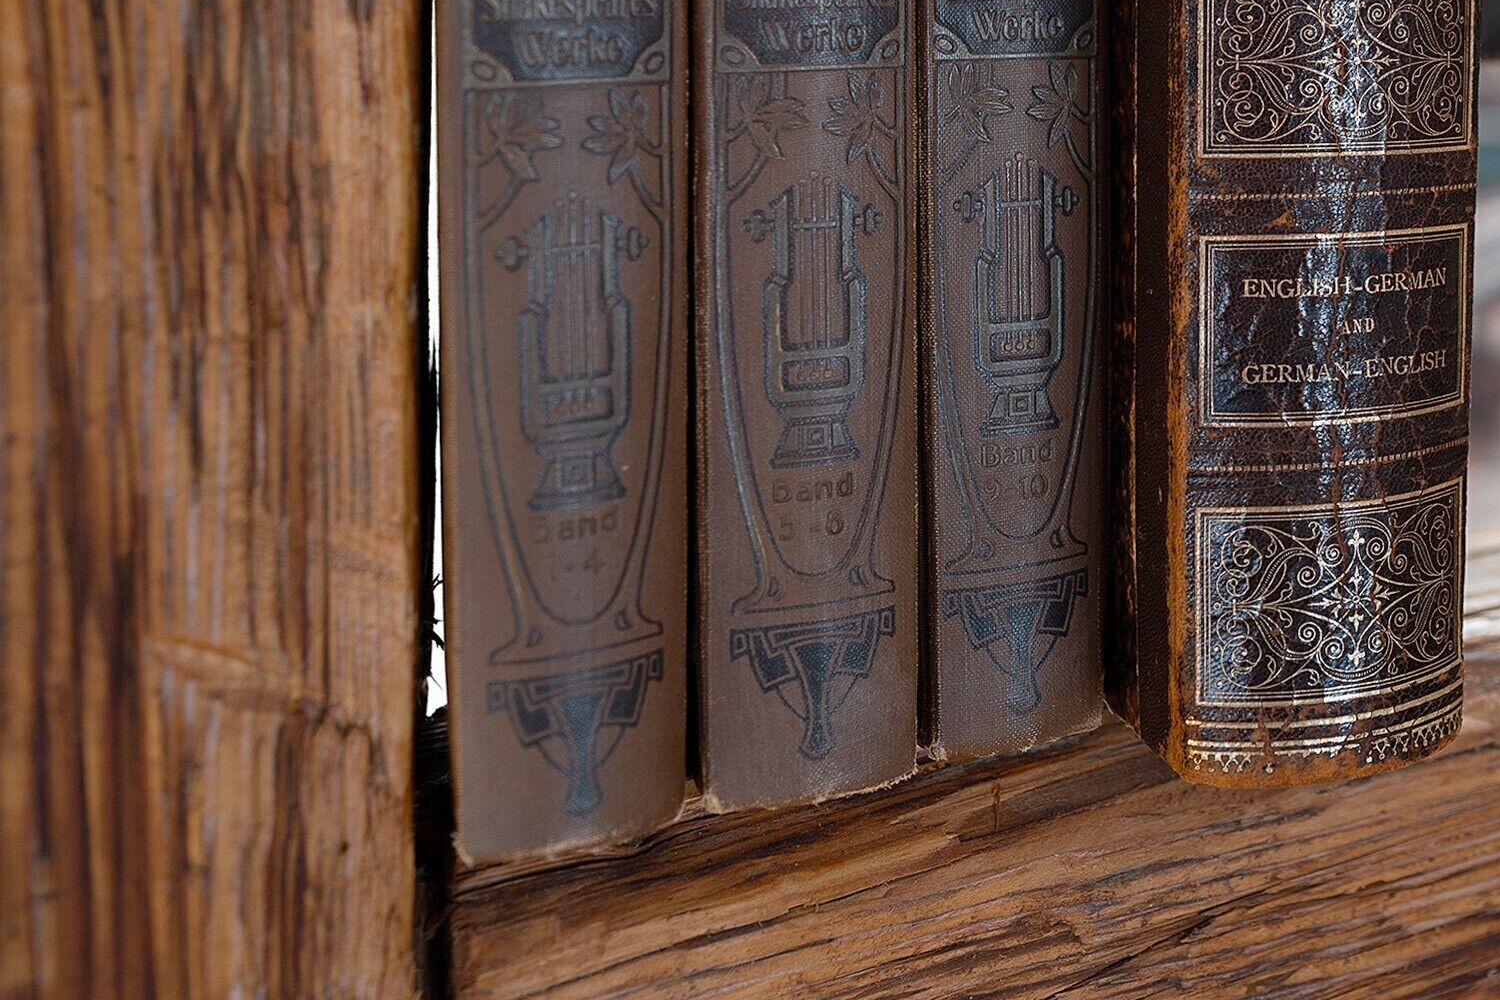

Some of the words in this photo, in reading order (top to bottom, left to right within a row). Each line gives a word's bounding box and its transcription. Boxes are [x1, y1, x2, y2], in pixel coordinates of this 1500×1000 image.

[758, 17, 867, 52] Werke
[972, 9, 1065, 41] Werke
[512, 30, 625, 67] Werke
[1242, 267, 1447, 298] ENGLISH-GERMAN
[1341, 317, 1375, 334] AND
[1241, 350, 1447, 385] GERMAN-ENGLISH
[981, 439, 1056, 467] Band
[771, 471, 853, 504] Band
[983, 474, 1049, 501] 9-10
[527, 504, 620, 543] Band
